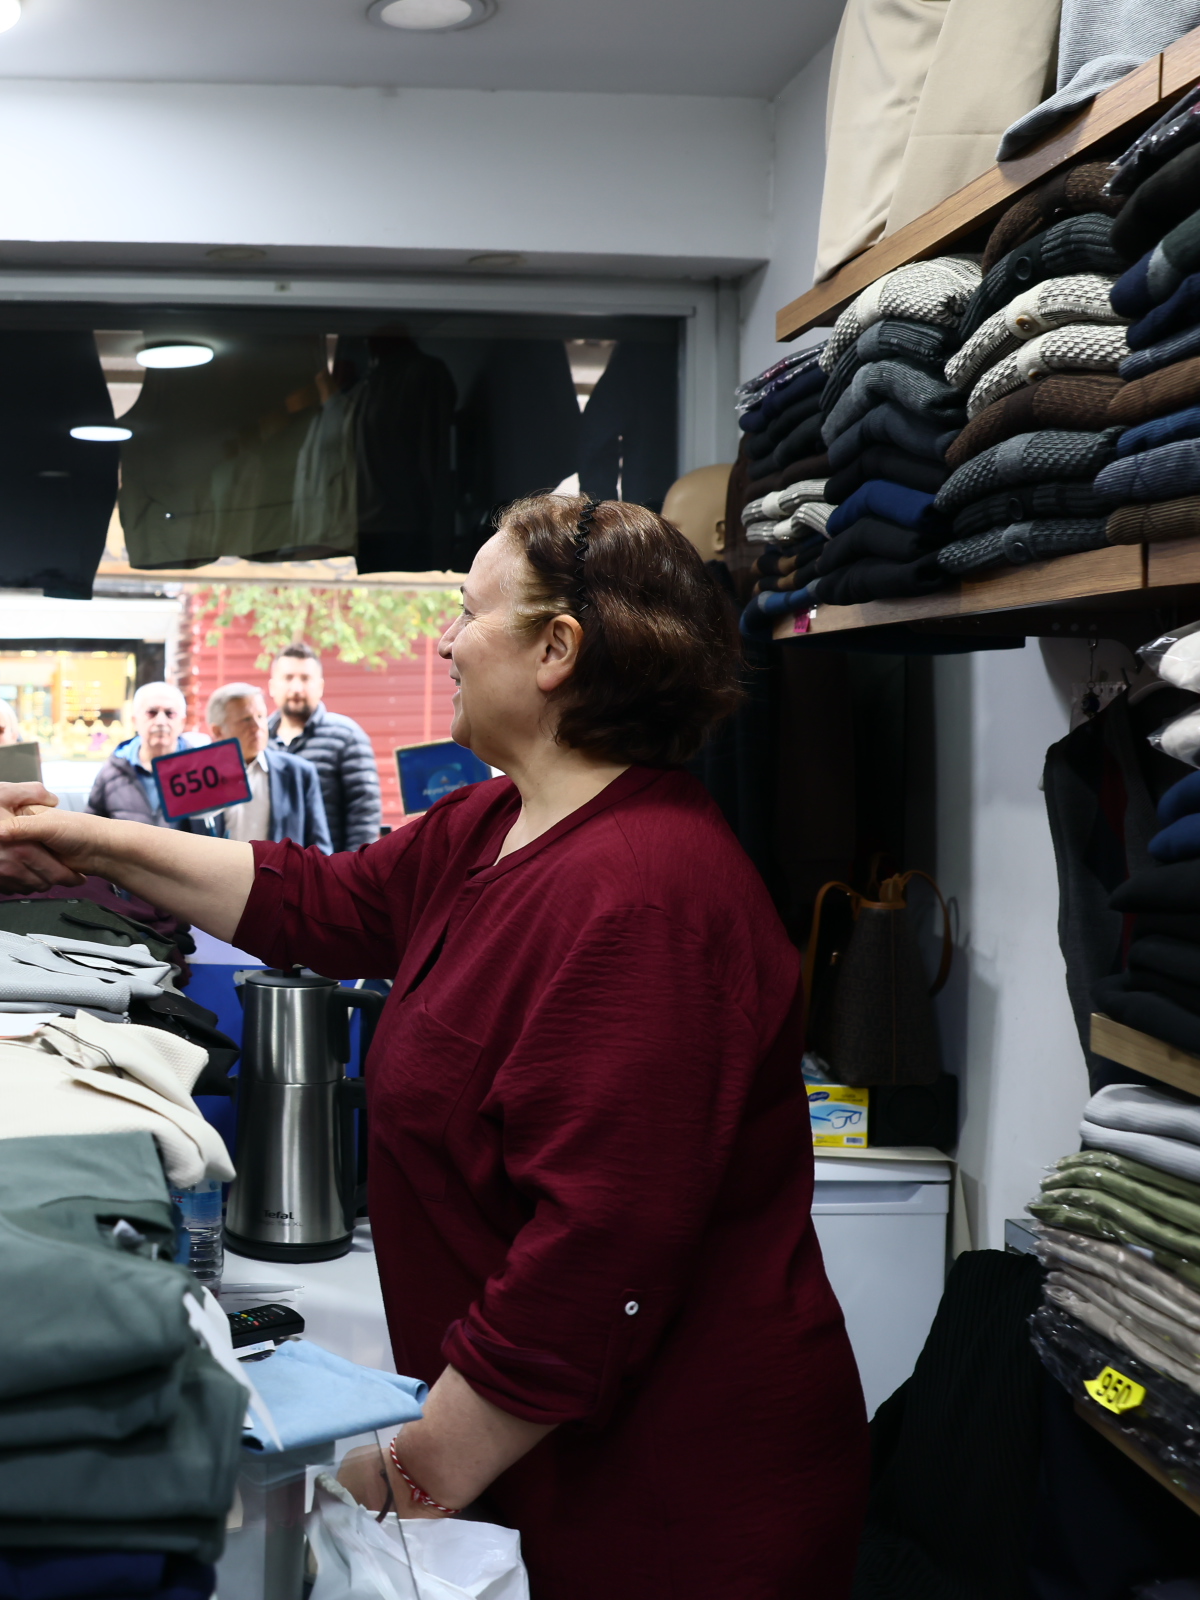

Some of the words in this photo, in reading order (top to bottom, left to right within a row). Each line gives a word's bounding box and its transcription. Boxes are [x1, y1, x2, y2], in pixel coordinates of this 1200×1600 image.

[169, 765, 219, 797] 650
[263, 1209, 295, 1220] Tefal
[1095, 1372, 1133, 1406] 950
